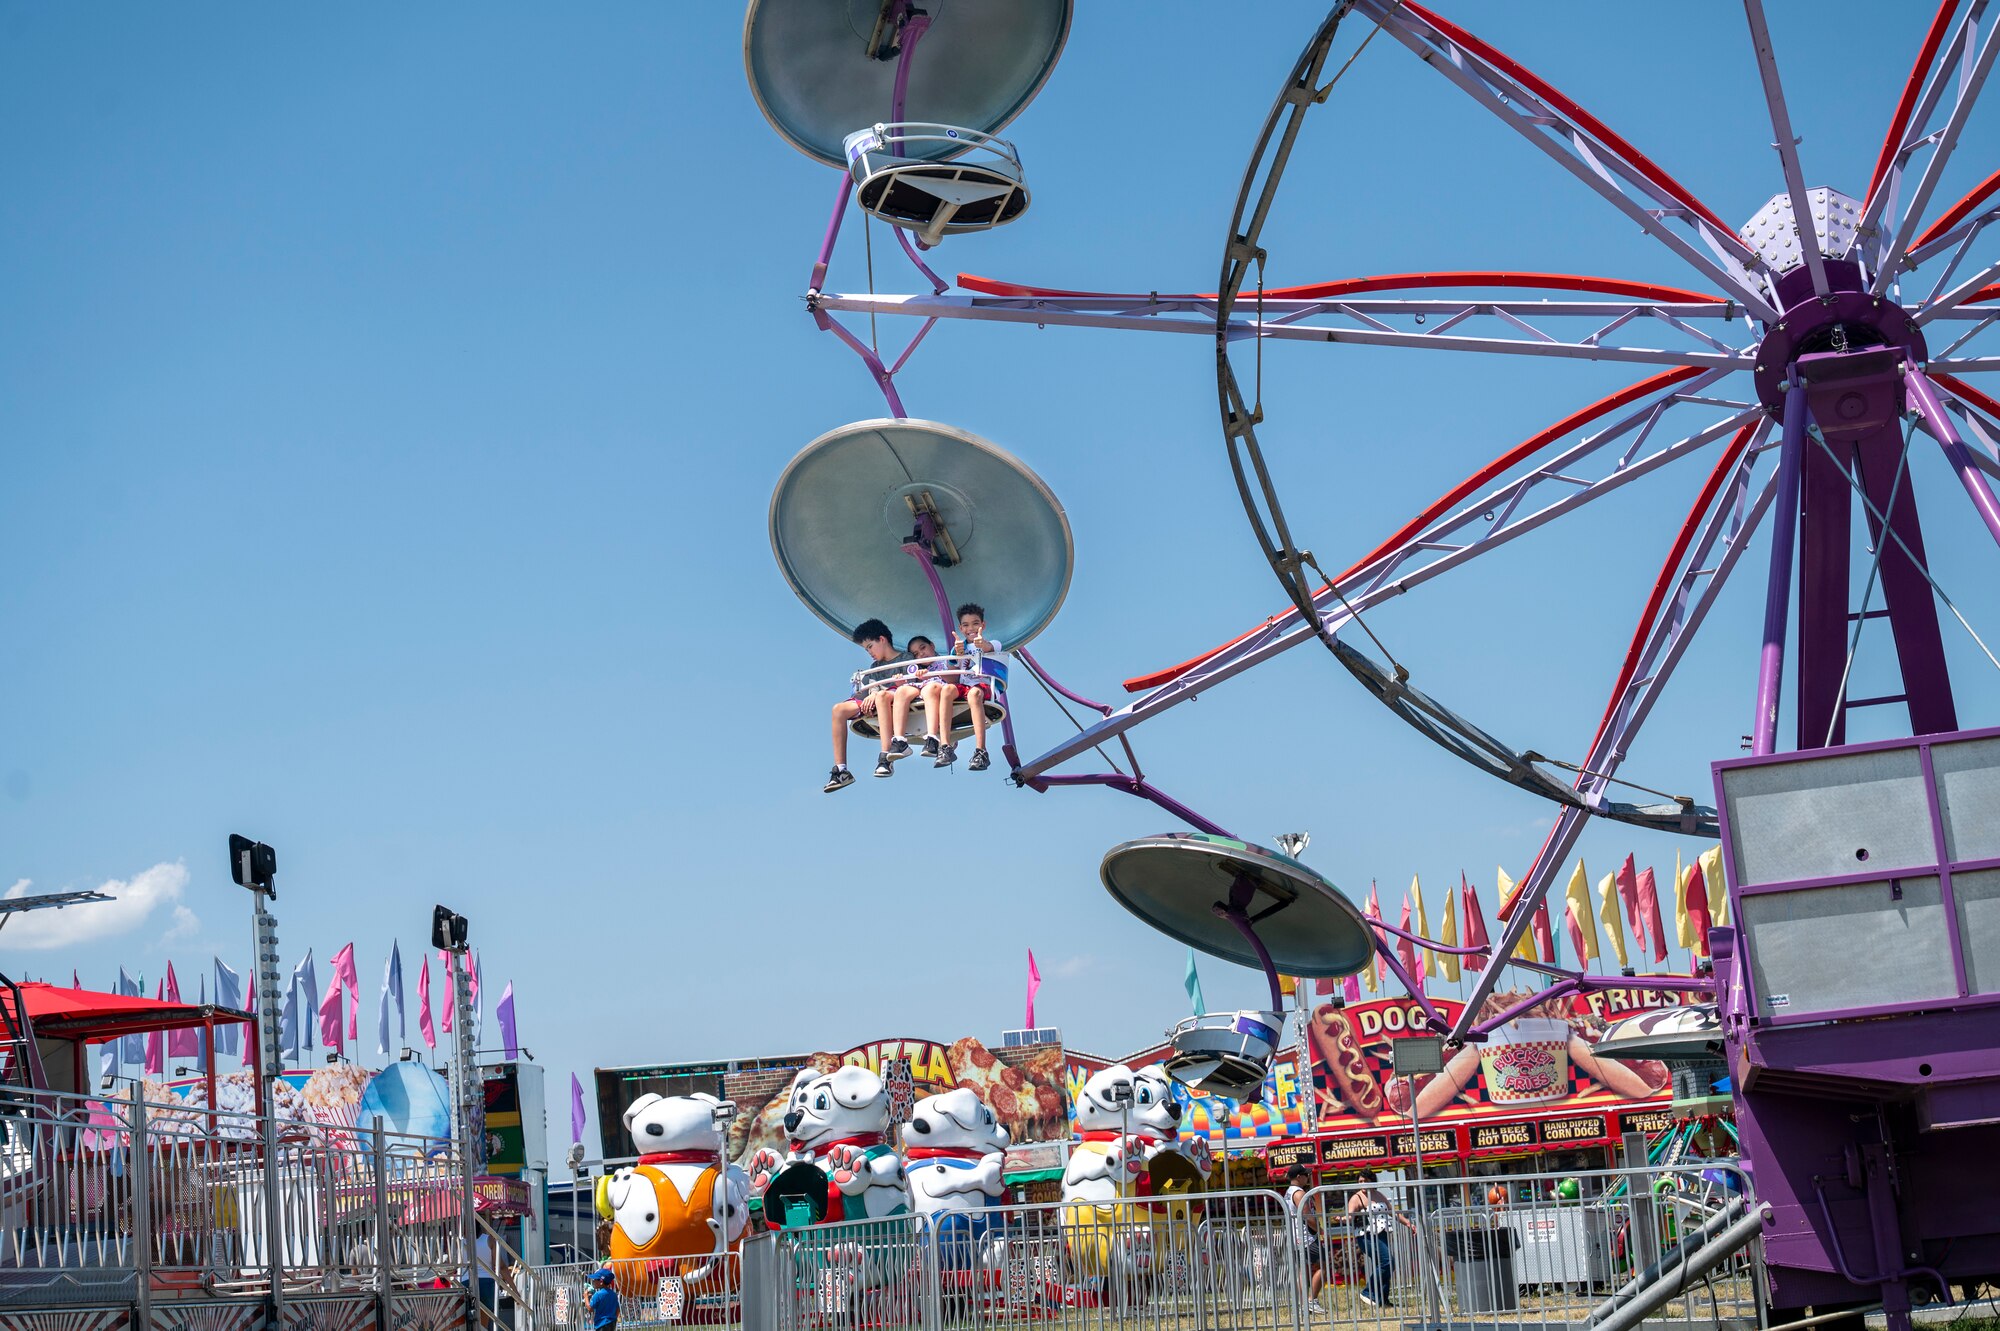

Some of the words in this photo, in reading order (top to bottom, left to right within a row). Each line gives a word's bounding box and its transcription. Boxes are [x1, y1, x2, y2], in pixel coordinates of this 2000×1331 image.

[1586, 989, 1681, 1016] FRIES
[1493, 1050, 1555, 1071] BUCKET
[889, 1080, 911, 1092] Puppy
[1505, 1073, 1550, 1090] FRIES
[894, 1092, 908, 1102] Roll
[1544, 1122, 1568, 1131] HAND
[1569, 1119, 1600, 1128] DIPPED
[1636, 1119, 1672, 1131] FRIES
[1478, 1129, 1498, 1138] ALL
[1500, 1125, 1527, 1135] BEEF
[1545, 1129, 1572, 1139] CORN
[1574, 1127, 1600, 1137] DOGS
[1332, 1139, 1376, 1150] SAUSAGE
[1477, 1136, 1500, 1146] HOT
[1501, 1133, 1530, 1144] DOGS
[1325, 1146, 1385, 1160] SANDWICHES
[1274, 1154, 1298, 1165] FRIES
[662, 1291, 678, 1300] Puppy
